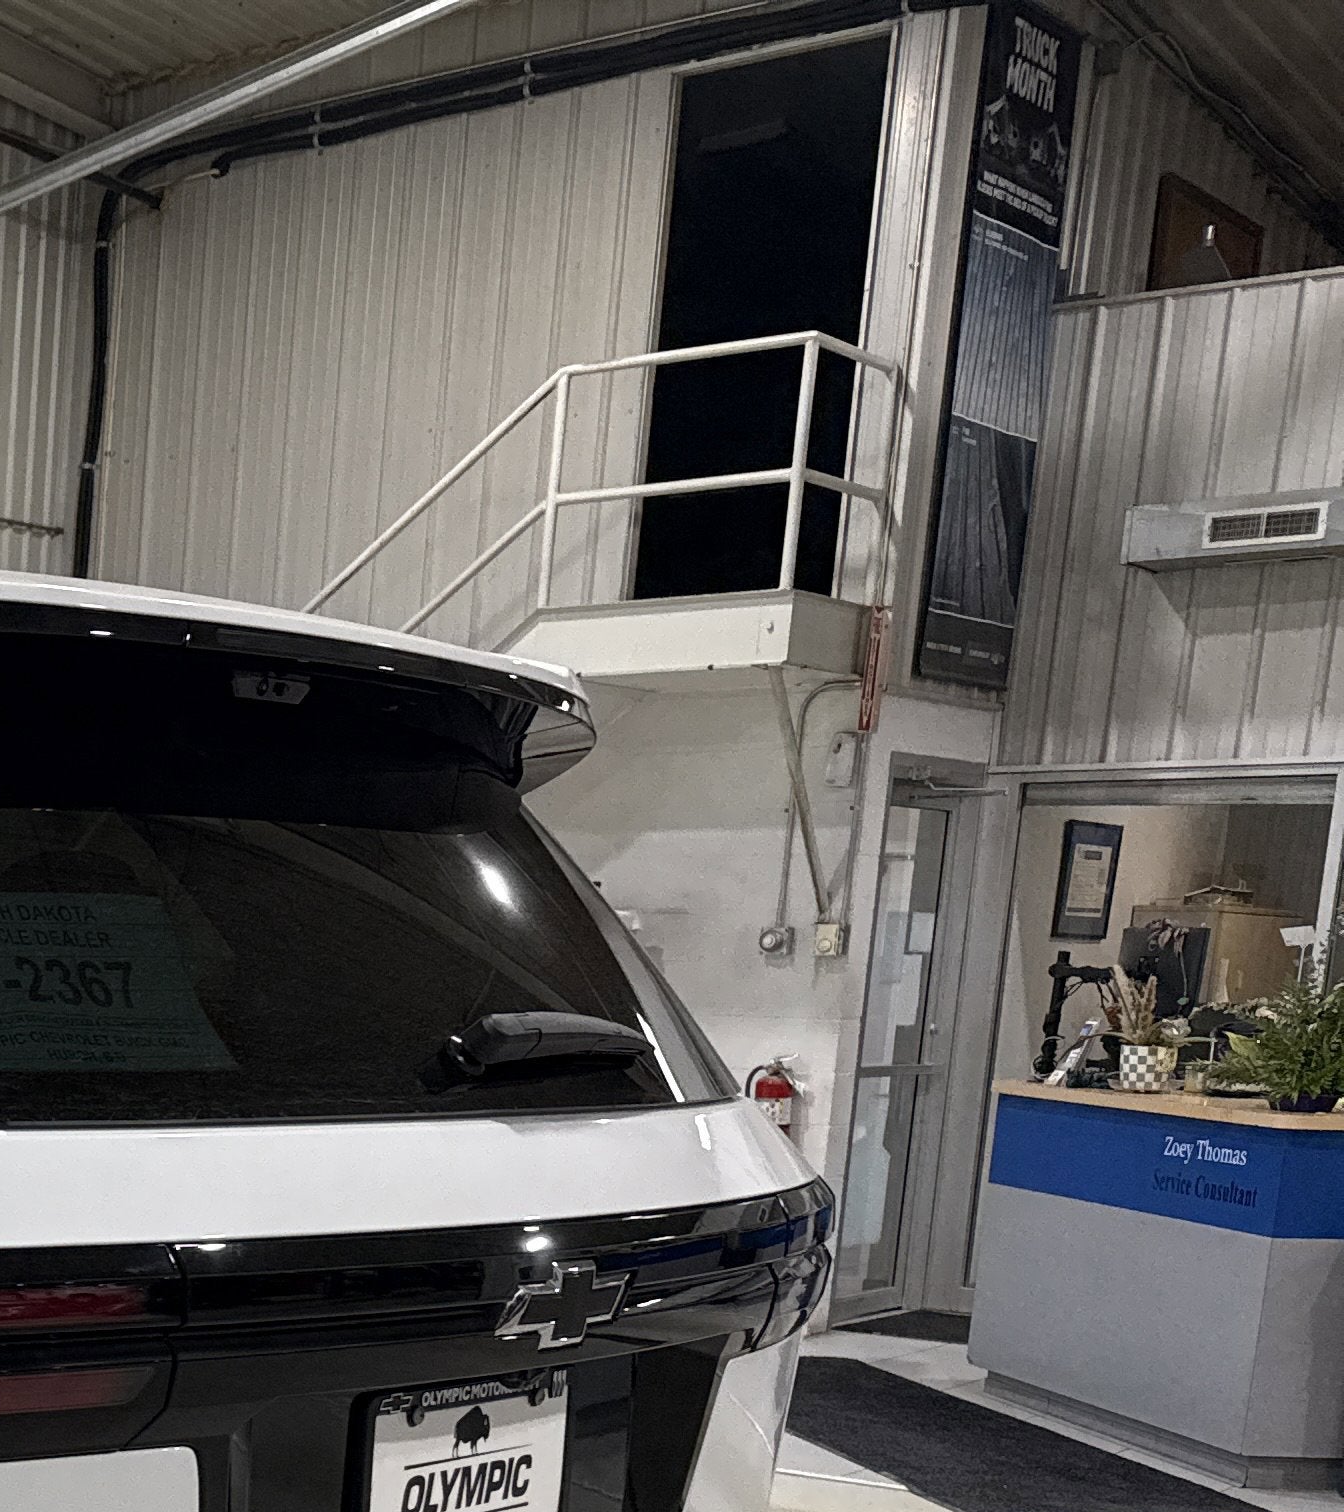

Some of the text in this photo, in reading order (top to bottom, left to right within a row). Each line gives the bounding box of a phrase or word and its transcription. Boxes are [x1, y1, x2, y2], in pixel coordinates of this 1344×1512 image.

[1015, 16, 1060, 75] TRUCK
[1006, 55, 1056, 113] MONTH
[16, 904, 96, 923] DAKOTA
[36, 930, 111, 948] DEALER
[1164, 1136, 1248, 1165] Zoey Thomas
[1152, 1168, 1258, 1208] Service Consultant
